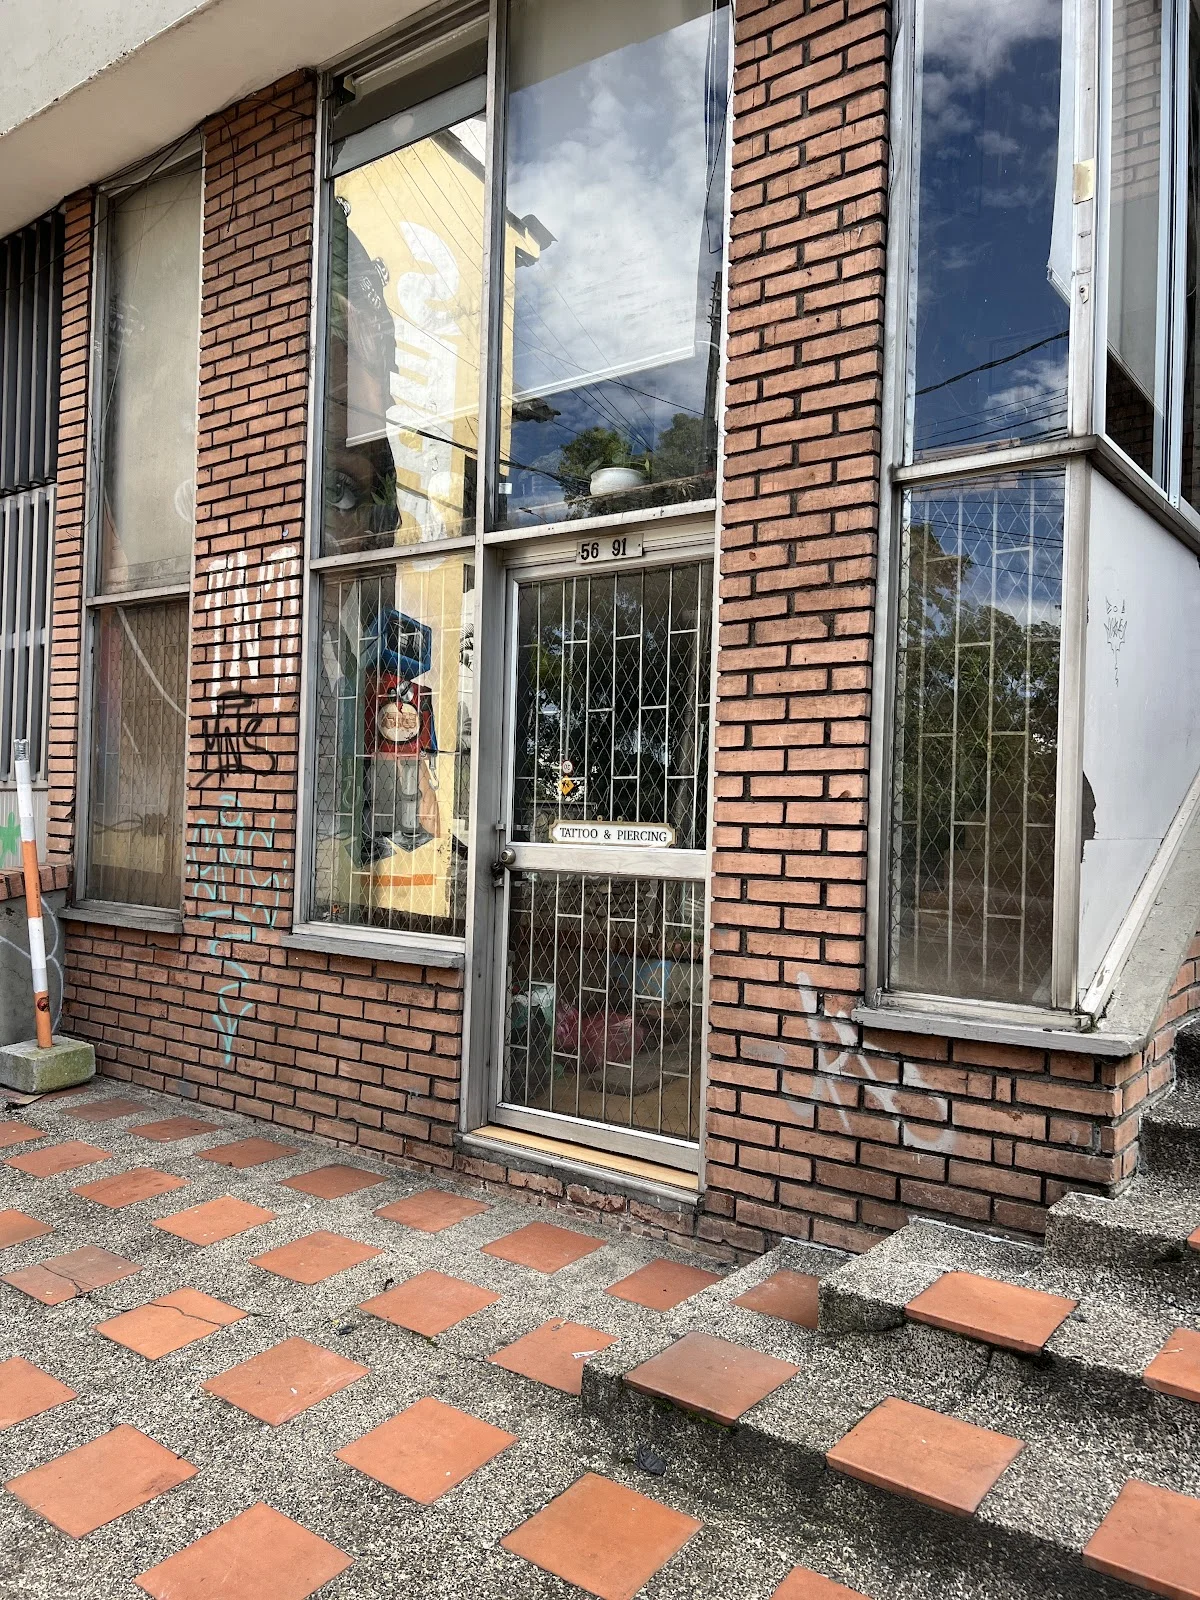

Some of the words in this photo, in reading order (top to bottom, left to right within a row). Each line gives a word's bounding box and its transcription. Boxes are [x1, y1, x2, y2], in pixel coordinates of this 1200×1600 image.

[580, 542, 599, 560] 56
[612, 537, 627, 556] 91
[560, 827, 598, 839] TATTOO
[603, 829, 612, 840] &
[617, 830, 667, 842] PIERCING
